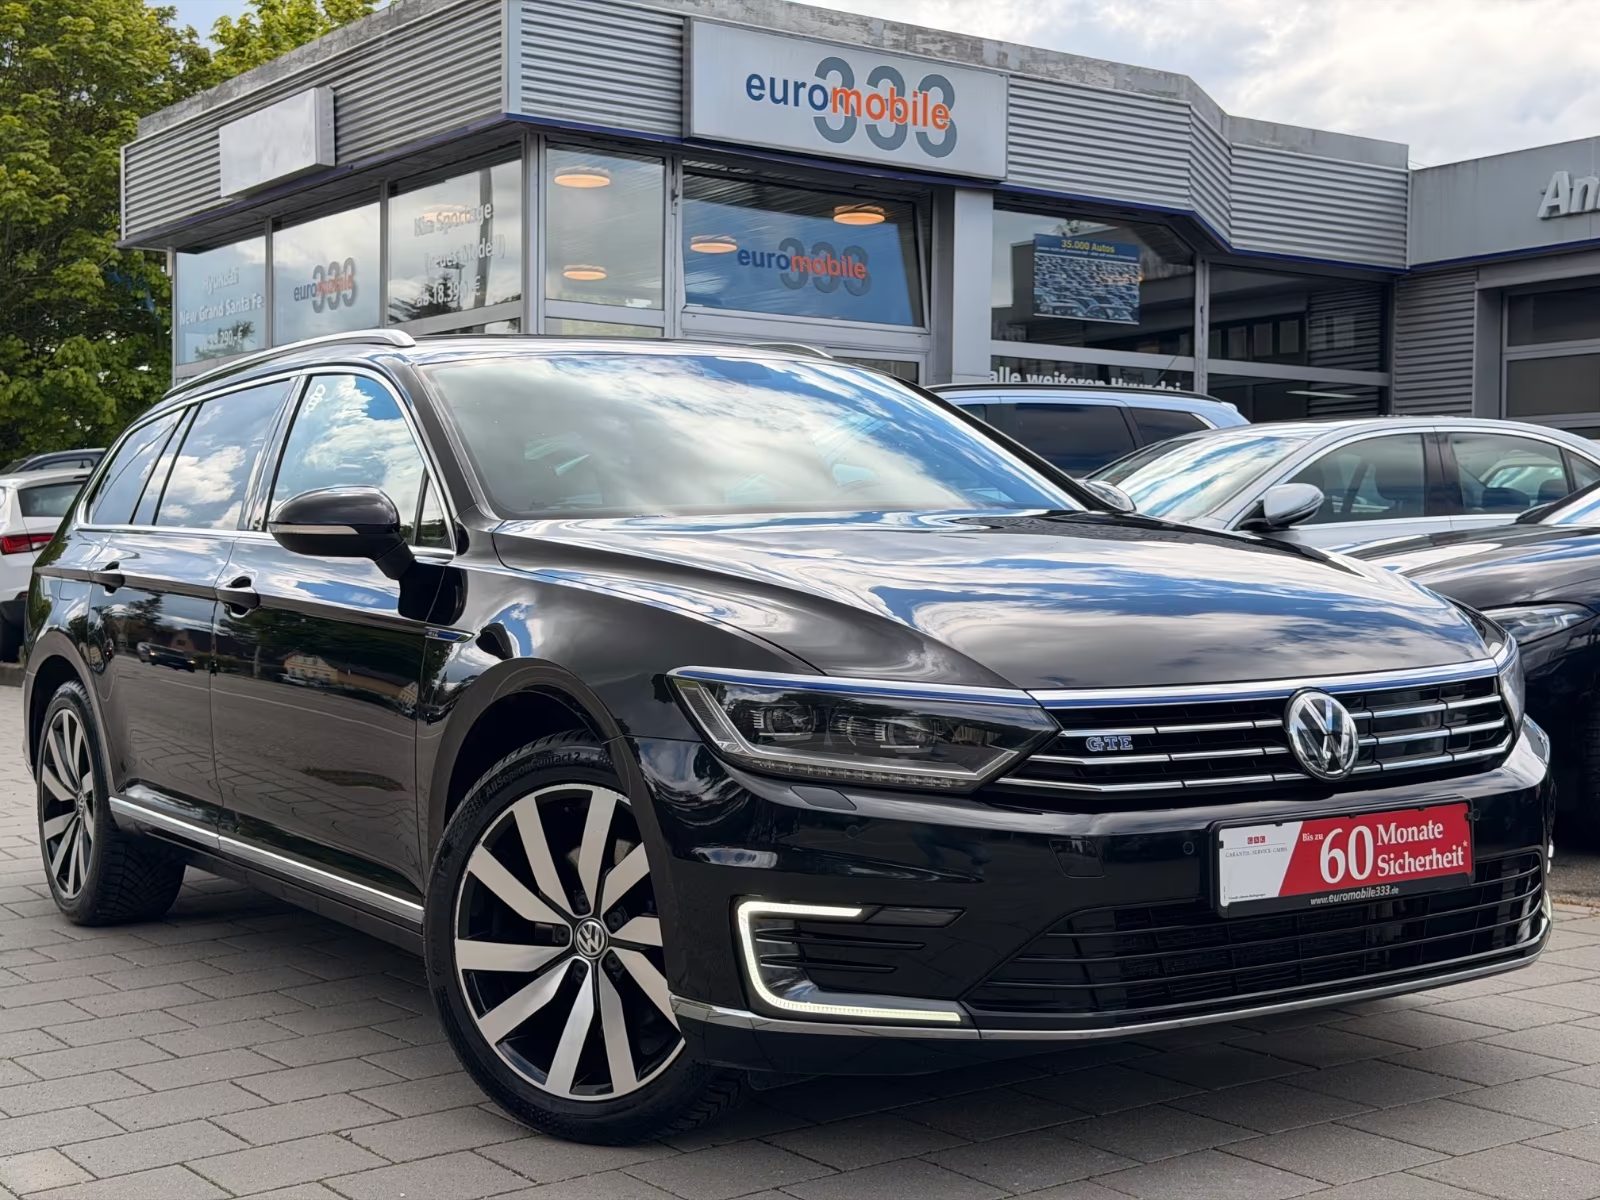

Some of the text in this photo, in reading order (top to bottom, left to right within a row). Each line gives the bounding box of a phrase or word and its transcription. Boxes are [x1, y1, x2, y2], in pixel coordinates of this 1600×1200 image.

[745, 73, 951, 130] euromobile
[737, 249, 866, 279] euromobile
[200, 304, 224, 321] Grand
[225, 296, 250, 316] Santa
[989, 366, 1021, 384] alle
[1086, 735, 1133, 751] GTE
[1302, 832, 1324, 842] Bis zu
[1376, 820, 1444, 846] Monate
[1319, 825, 1375, 884] 60
[1310, 885, 1399, 905] www.euromobile333.de
